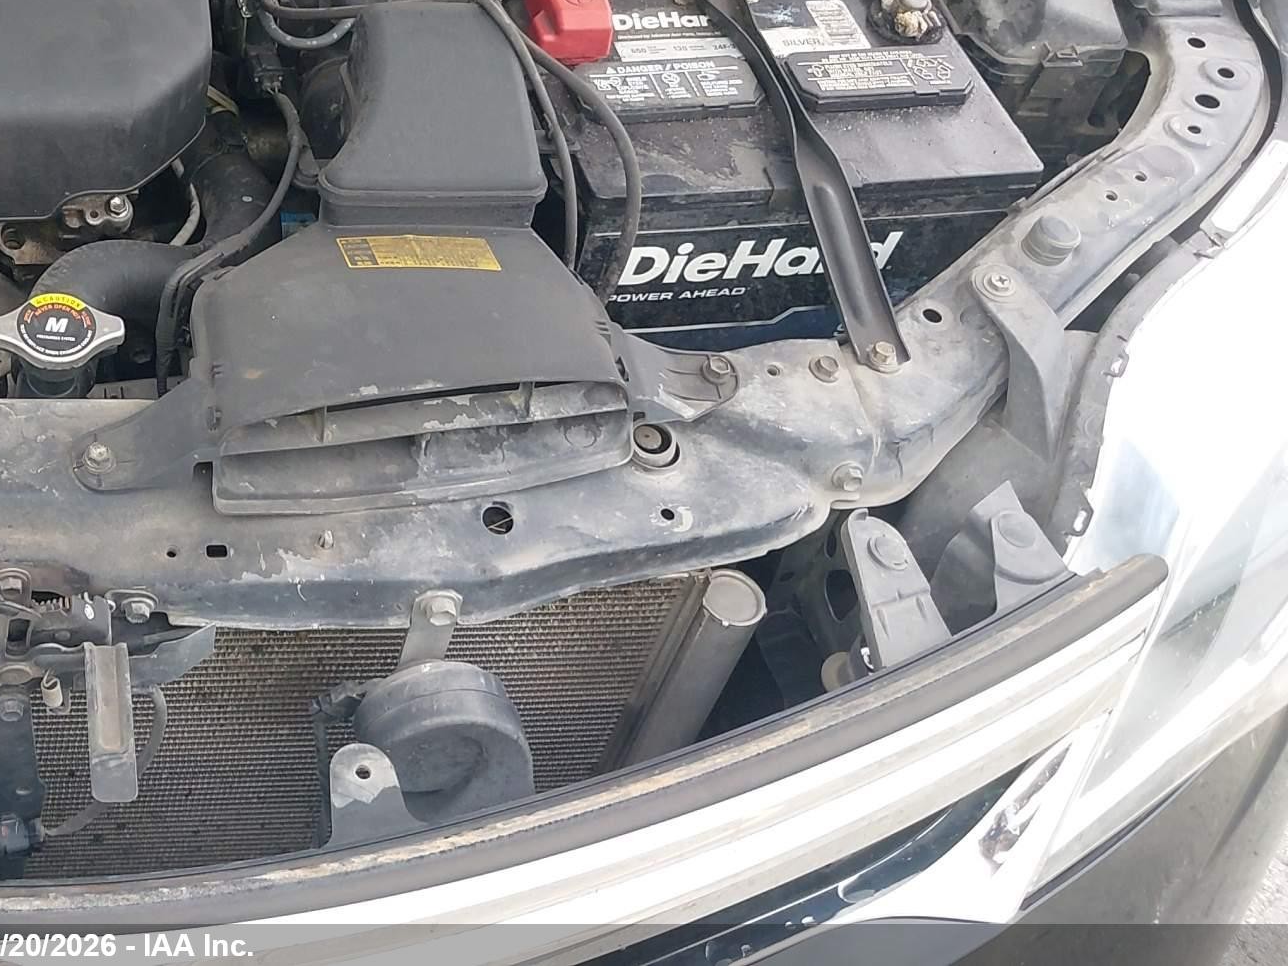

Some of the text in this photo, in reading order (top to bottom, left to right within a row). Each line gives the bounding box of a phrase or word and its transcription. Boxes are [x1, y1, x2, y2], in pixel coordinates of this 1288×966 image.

[612, 11, 712, 31] DieHar
[782, 38, 821, 47] SILVER
[617, 65, 661, 74] DANGER
[673, 61, 716, 71] POISON
[618, 231, 904, 285] DieHad
[43, 296, 81, 308] CAUTION
[608, 287, 746, 303] POWER AHEAD
[54, 303, 71, 312] OPEN
[45, 316, 69, 333] M
